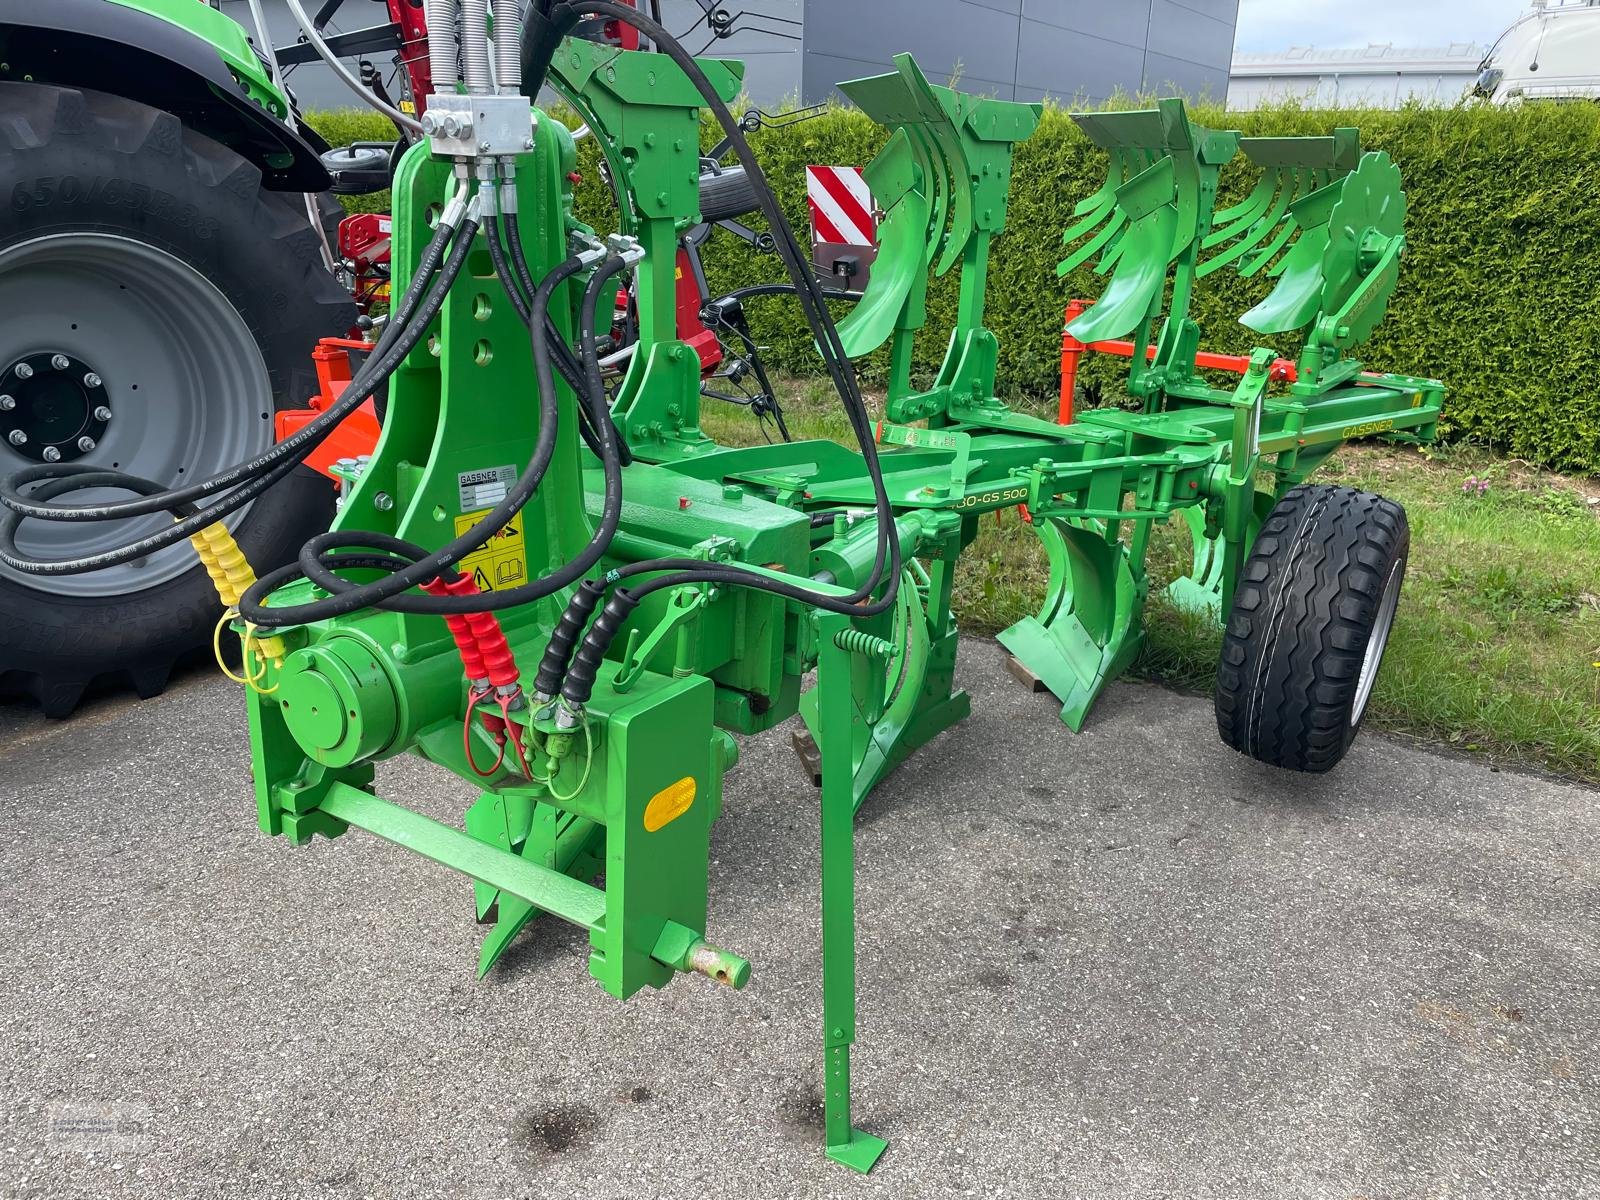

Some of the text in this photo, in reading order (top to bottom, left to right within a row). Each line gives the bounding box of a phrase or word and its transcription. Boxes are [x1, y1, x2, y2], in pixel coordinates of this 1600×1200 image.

[1342, 419, 1394, 439] GASSNER
[247, 426, 317, 471] ROCKMASTER/2SC
[460, 470, 497, 485] GASSNER
[1002, 487, 1028, 501] 500
